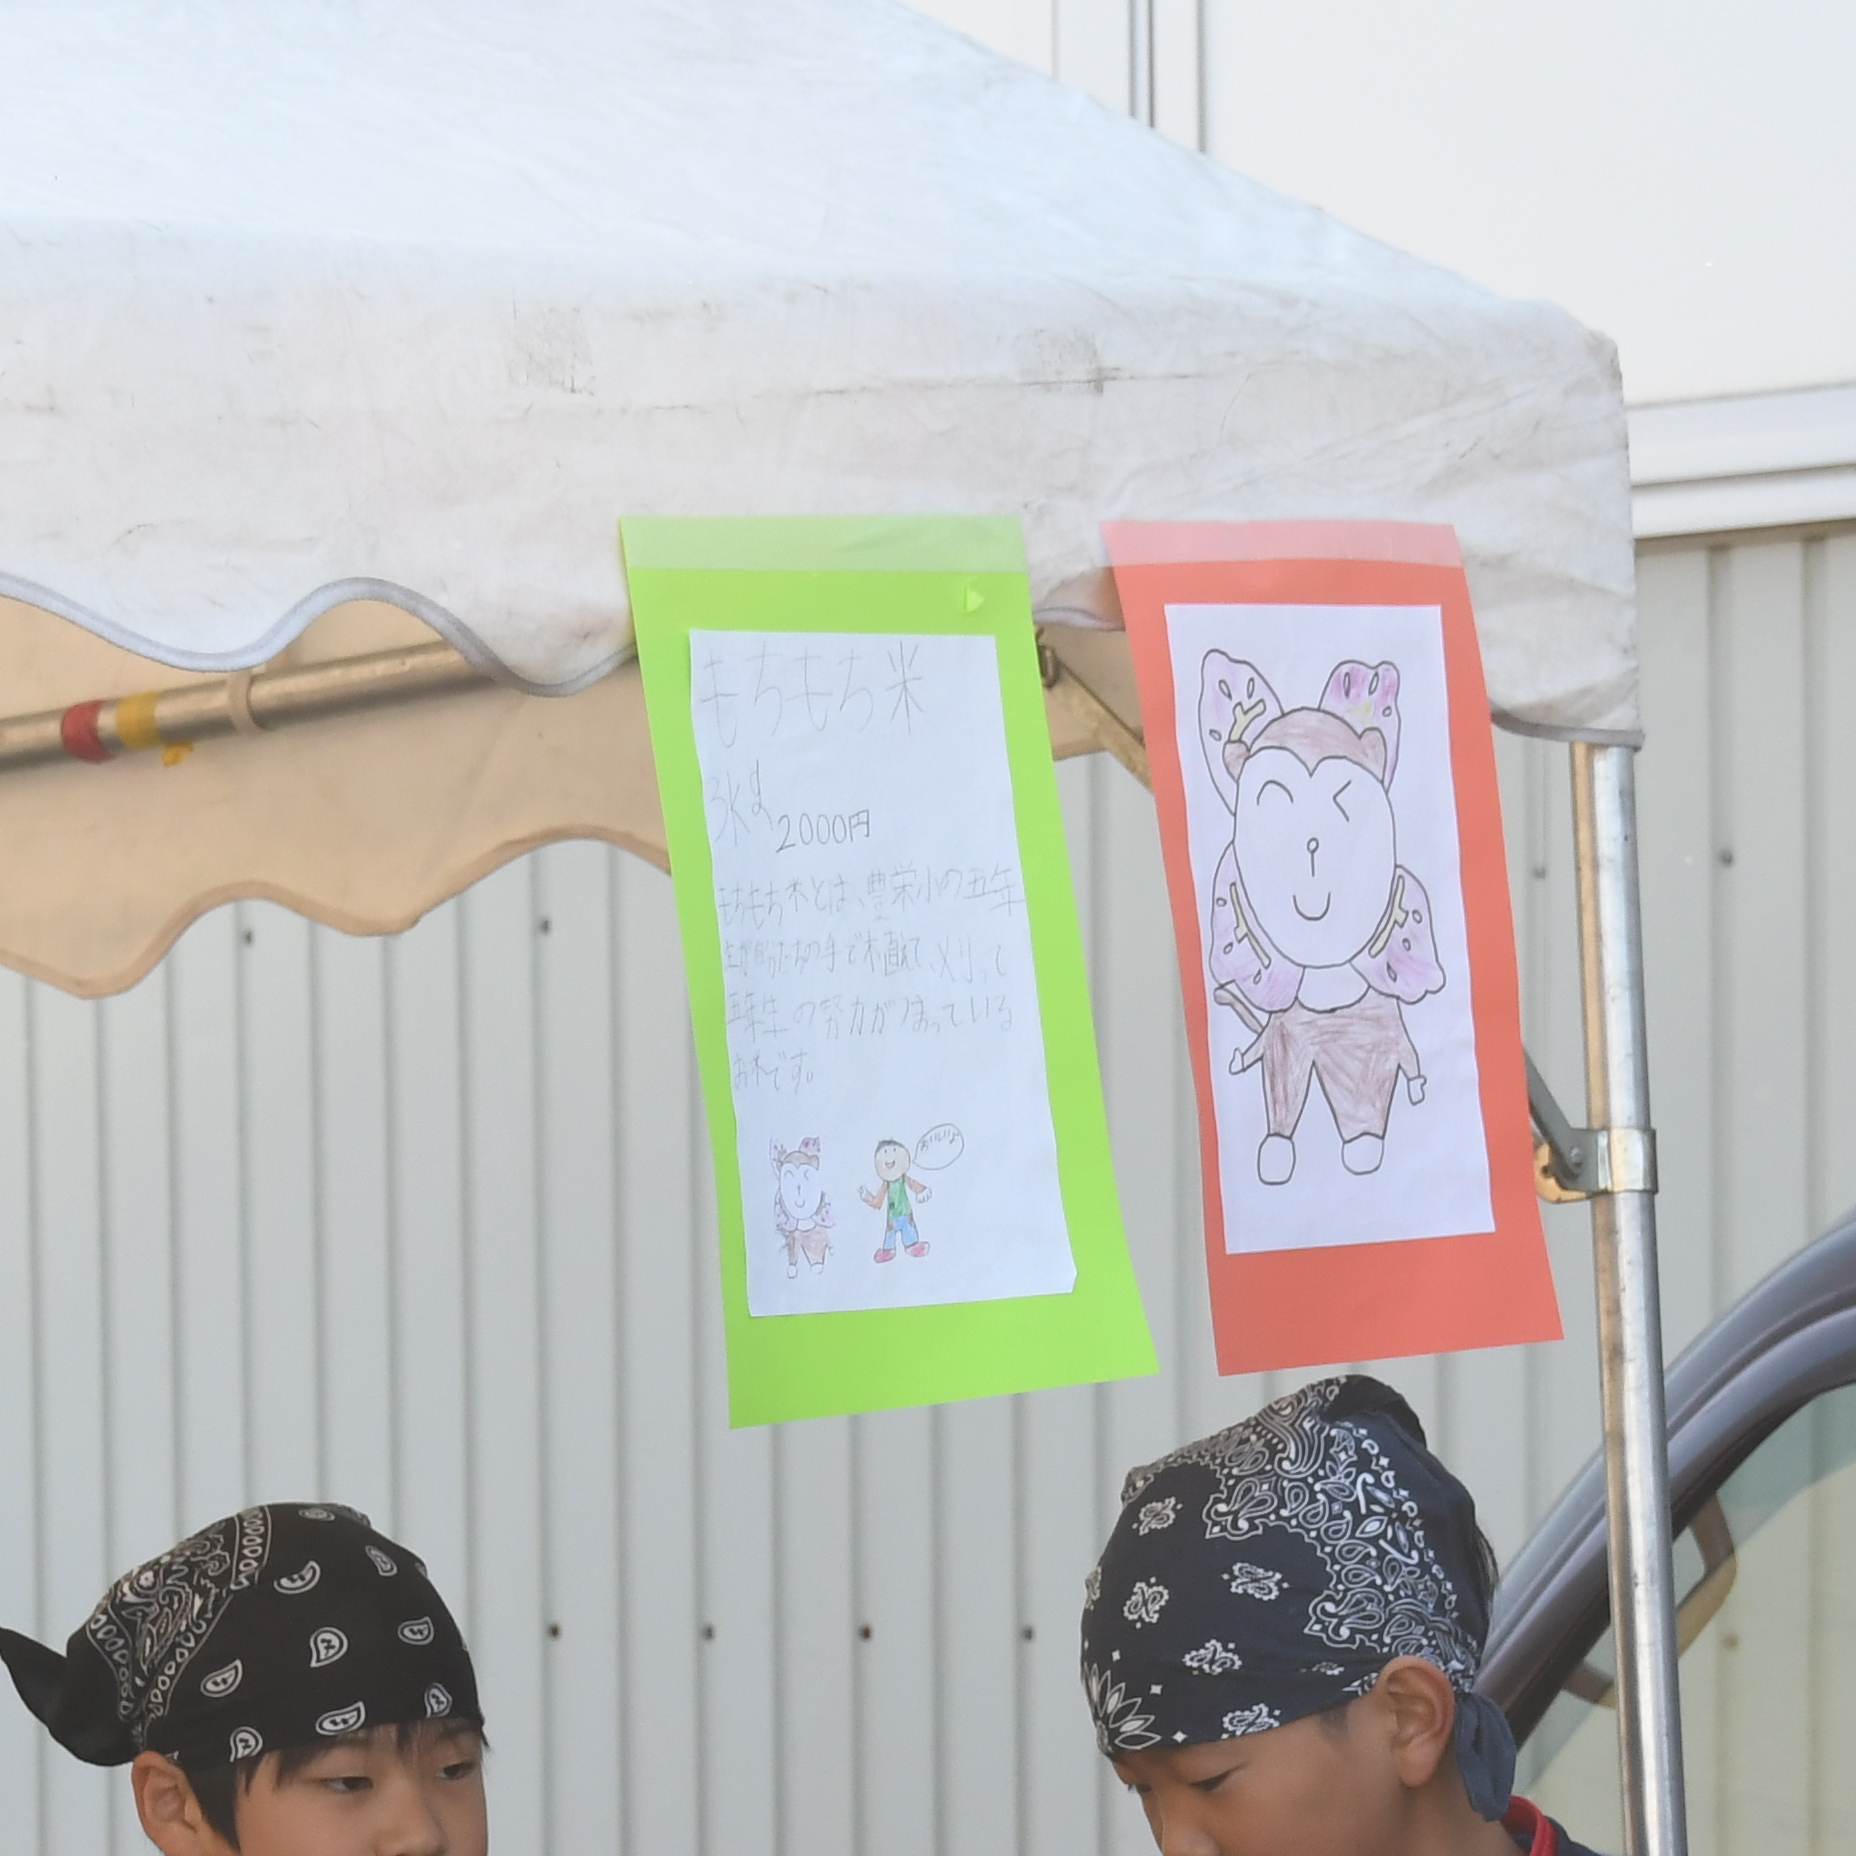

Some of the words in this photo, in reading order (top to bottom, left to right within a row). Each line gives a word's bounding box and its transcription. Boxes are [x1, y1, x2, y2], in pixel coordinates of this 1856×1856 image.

[701, 641, 925, 748] もちもち米
[776, 809, 871, 853] 2000円
